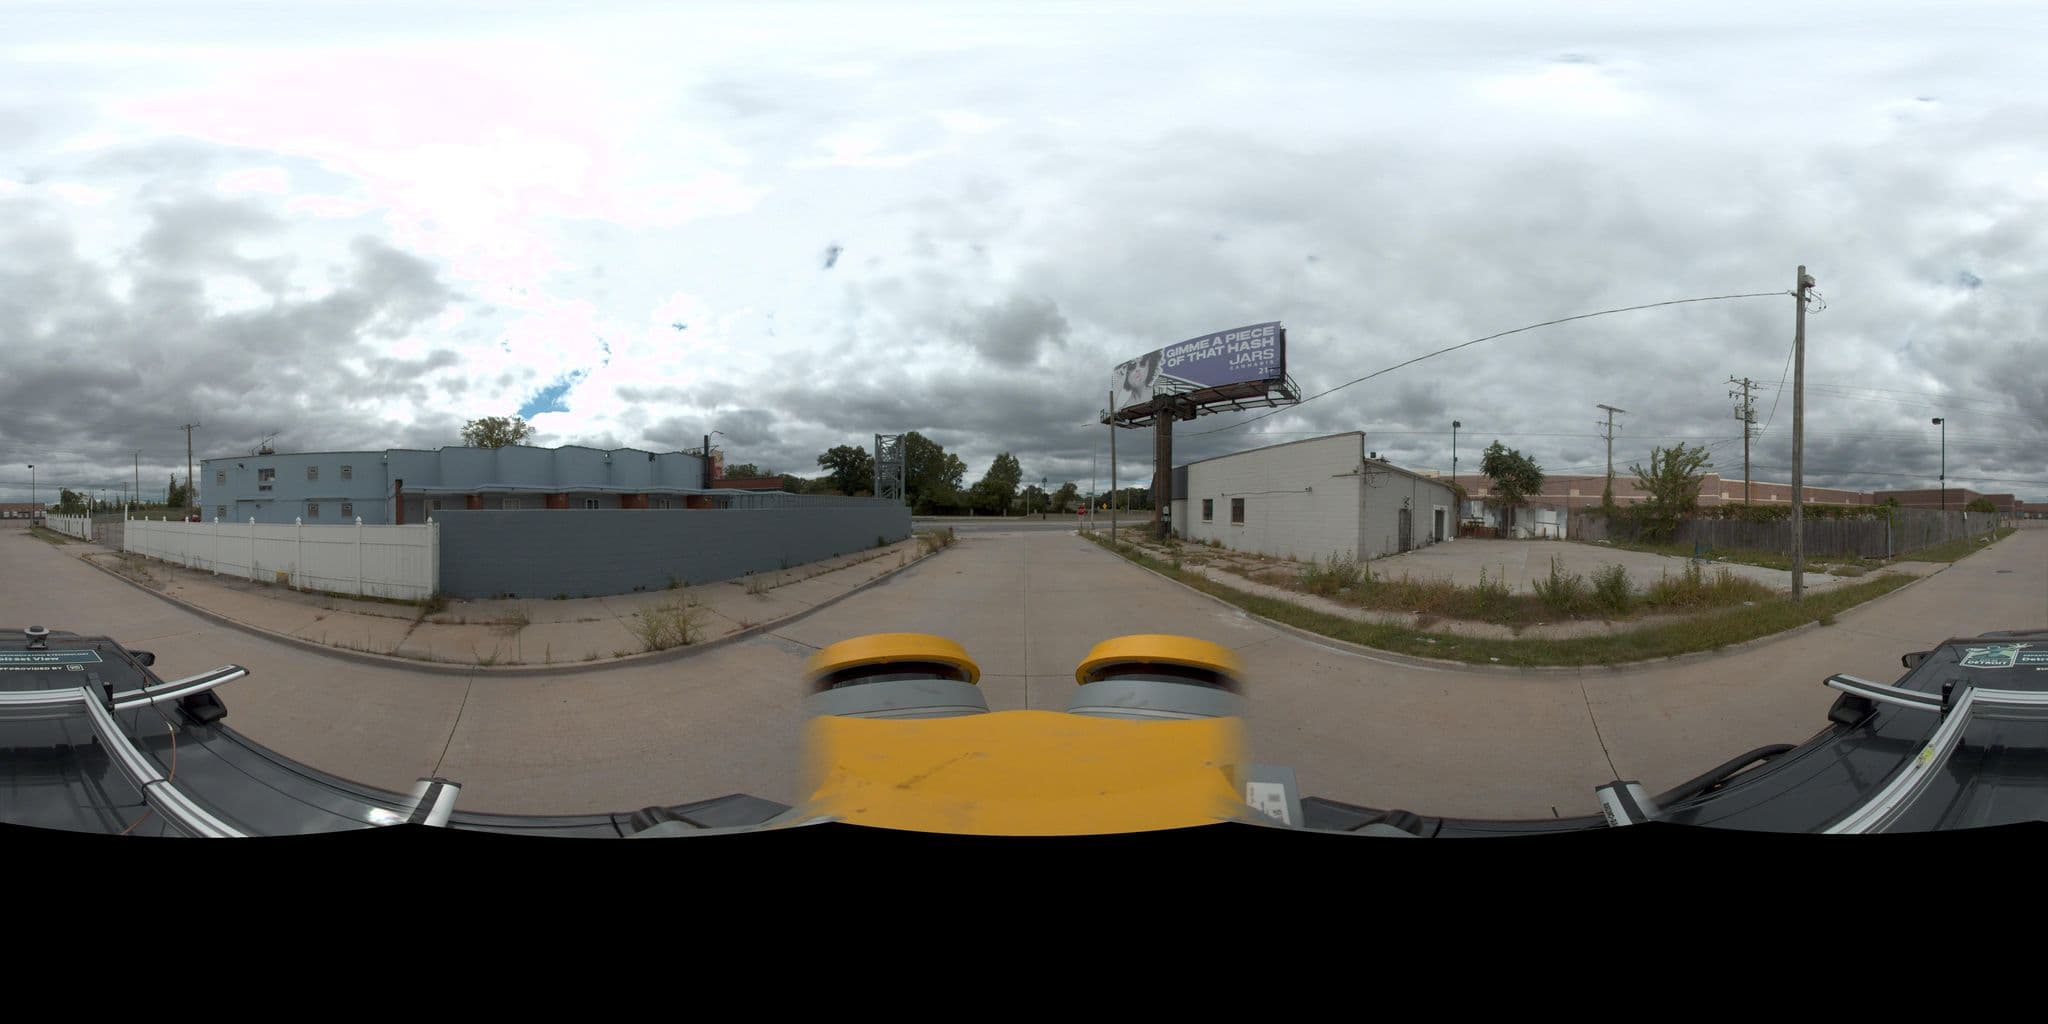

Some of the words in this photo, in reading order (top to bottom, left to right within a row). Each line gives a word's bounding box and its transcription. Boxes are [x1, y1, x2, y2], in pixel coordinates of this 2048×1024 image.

[1166, 339, 1210, 358] GIMME
[1212, 336, 1223, 347] A
[1225, 326, 1275, 343] PIECE
[1167, 355, 1185, 367] OF
[1187, 345, 1225, 362] THAT
[1227, 336, 1274, 353] HASH
[1229, 348, 1275, 365] JARS
